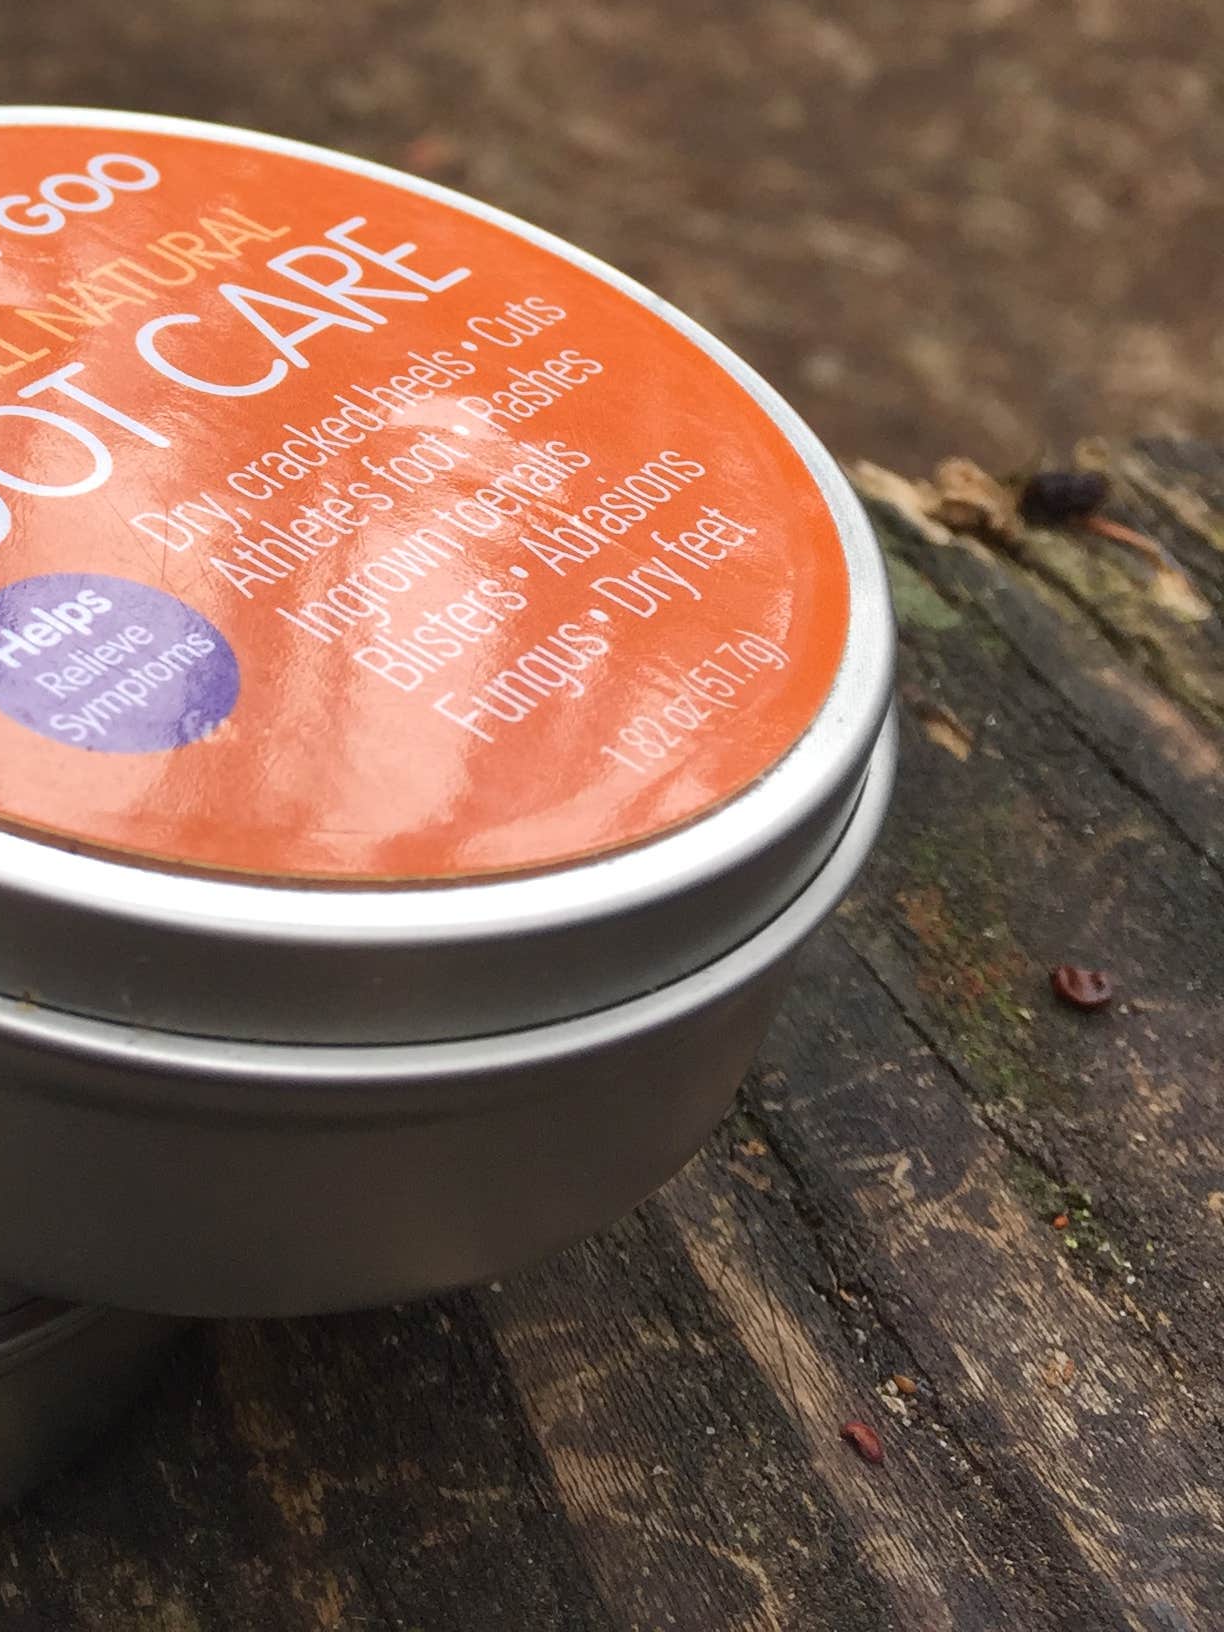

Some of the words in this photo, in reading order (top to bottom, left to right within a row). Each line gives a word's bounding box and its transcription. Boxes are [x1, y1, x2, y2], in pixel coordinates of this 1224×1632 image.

[15, 207, 291, 343] NATURAL
[135, 216, 472, 397] CARE
[130, 492, 252, 553] Dry,
[226, 394, 388, 501] cracked
[351, 350, 478, 420] heels
[466, 295, 567, 349] Cuts
[208, 480, 396, 599] Athlete's
[361, 431, 470, 493] foot
[457, 348, 604, 433] Rashes
[275, 527, 466, 646] Ingrown
[437, 439, 591, 539] toenails
[352, 577, 530, 692] Blisters
[518, 449, 706, 577] Abrasions
[431, 622, 611, 745] Fungus
[589, 555, 703, 619] Dry
[651, 504, 758, 572] feet
[35, 624, 154, 699] Relieve
[49, 632, 216, 742] Symptoms
